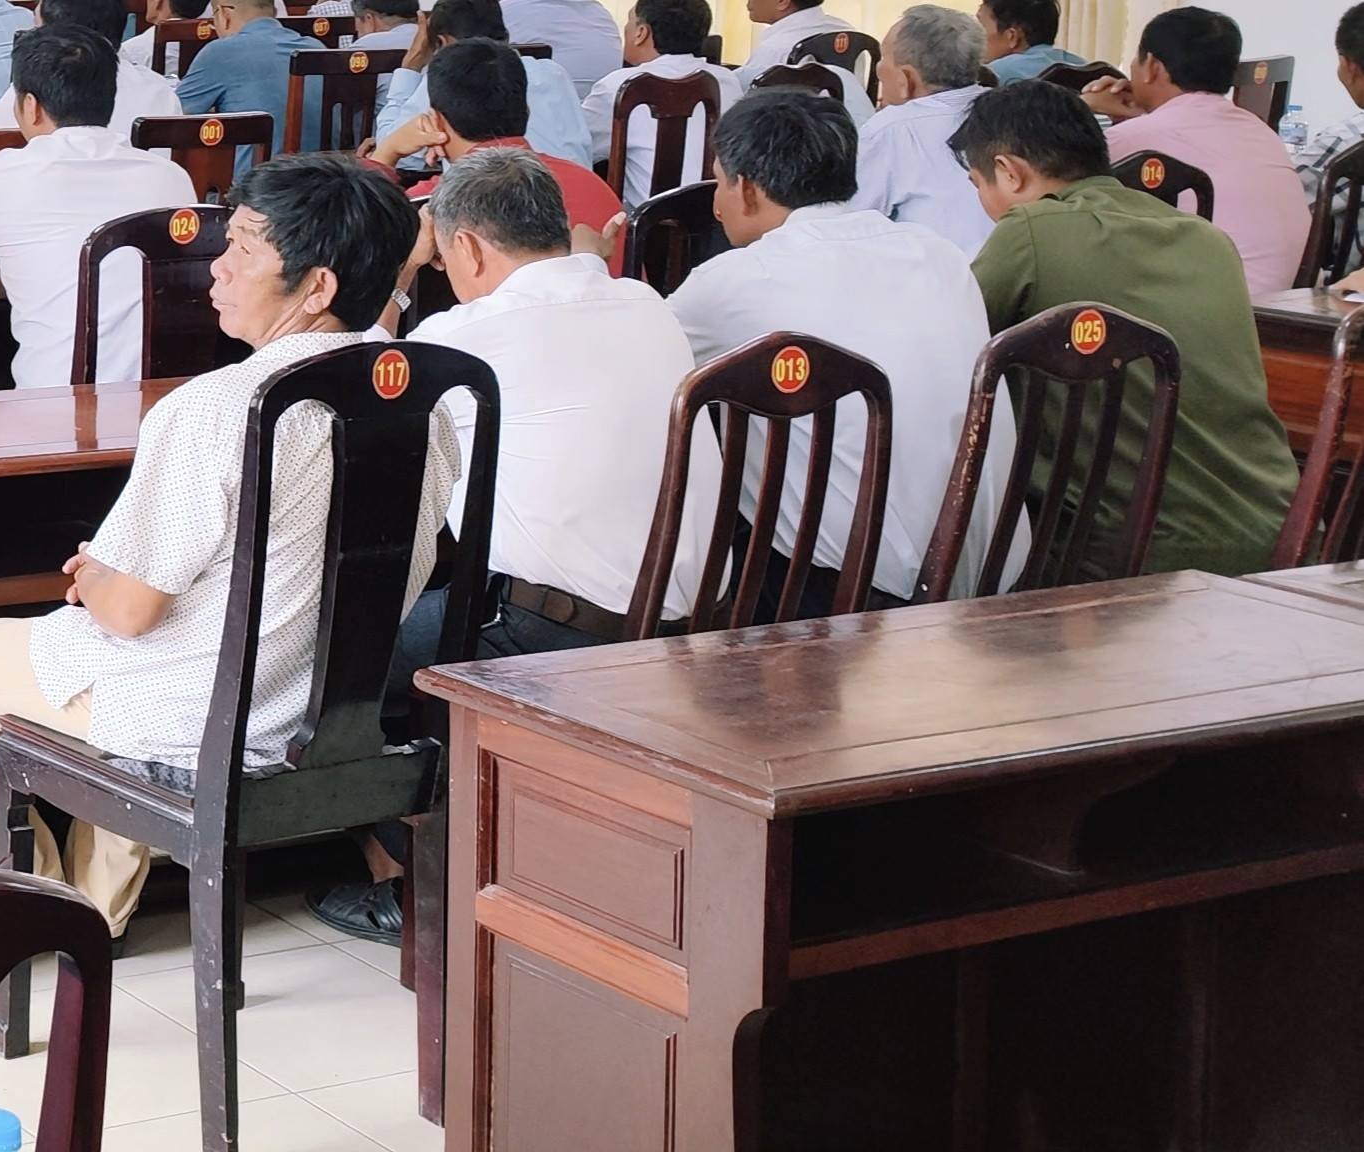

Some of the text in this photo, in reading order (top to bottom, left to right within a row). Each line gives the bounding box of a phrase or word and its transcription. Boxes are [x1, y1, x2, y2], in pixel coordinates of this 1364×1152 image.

[202, 125, 221, 140] 001
[1143, 165, 1161, 182] 014
[172, 218, 198, 237] 024
[1075, 321, 1103, 344] 025
[376, 361, 408, 388] 117
[776, 359, 807, 383] 013
